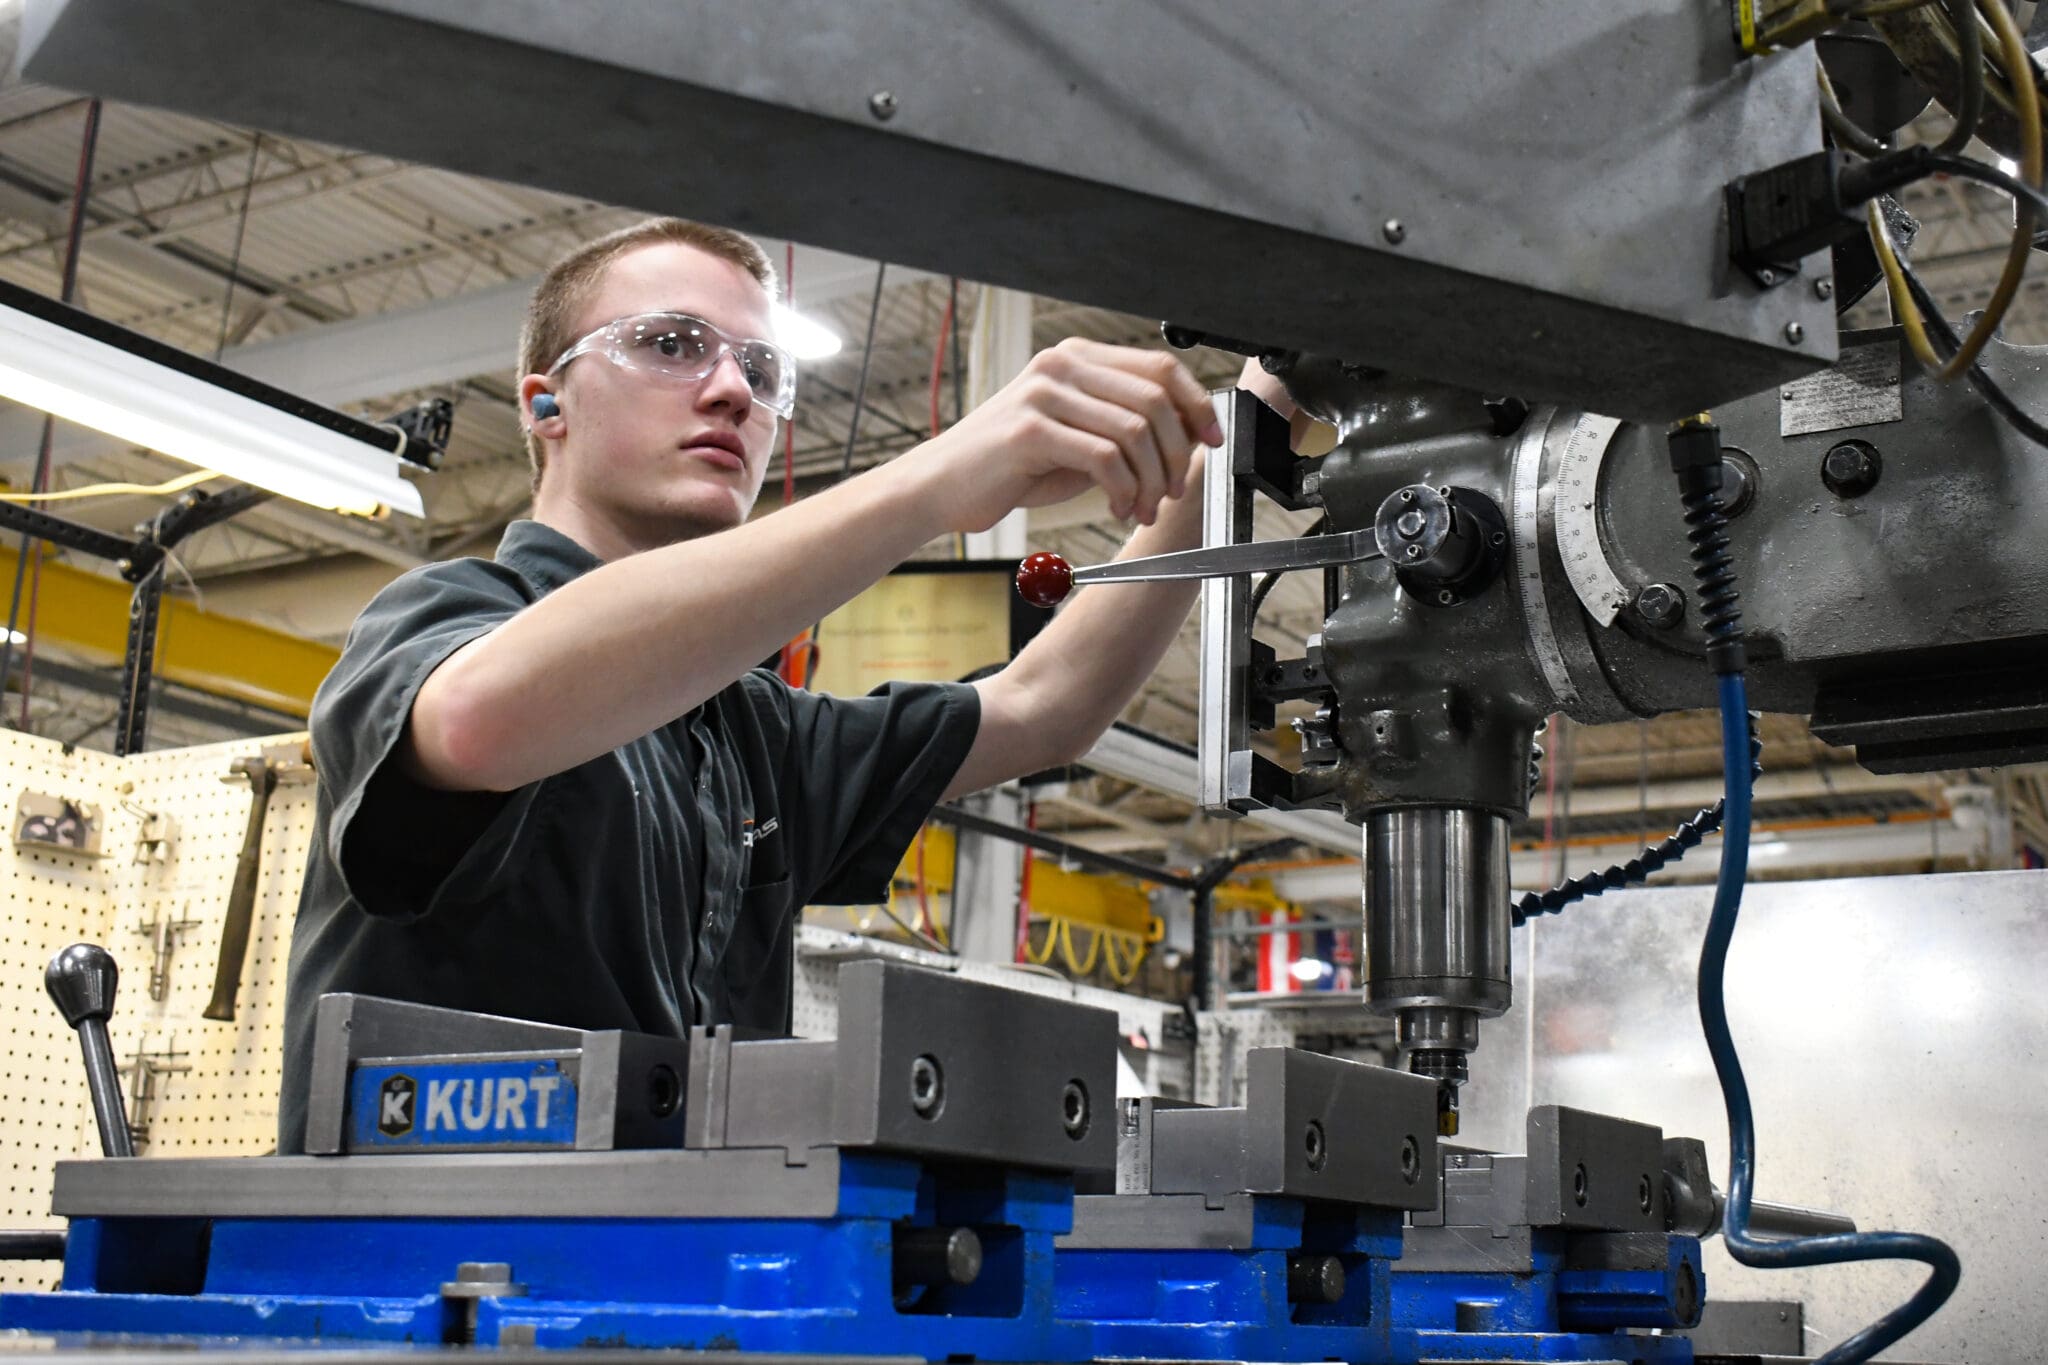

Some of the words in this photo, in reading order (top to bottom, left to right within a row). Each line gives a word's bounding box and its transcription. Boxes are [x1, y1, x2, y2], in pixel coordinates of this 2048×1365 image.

[1587, 430, 1598, 439] 30
[1578, 454, 1588, 462] 20
[1572, 479, 1581, 487] 10
[1572, 529, 1581, 537] 10
[1526, 542, 1536, 550] 30
[1576, 551, 1588, 561] 20
[1586, 573, 1597, 584] 30
[382, 1091, 412, 1125] K
[425, 1076, 560, 1132] KURT
